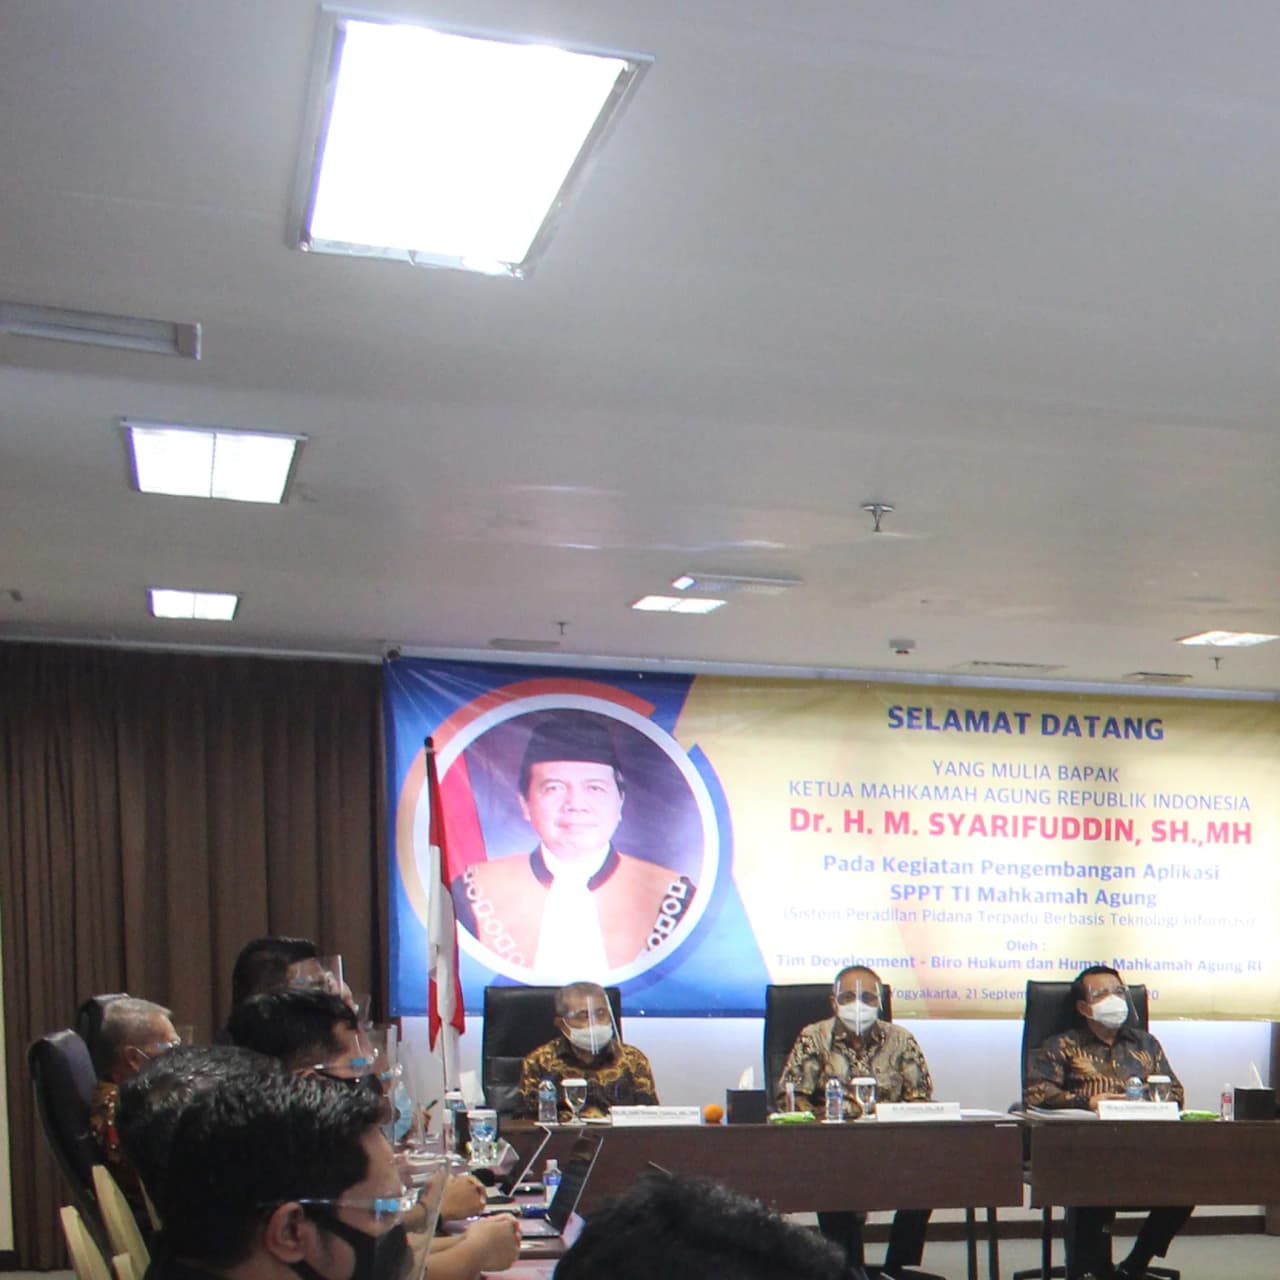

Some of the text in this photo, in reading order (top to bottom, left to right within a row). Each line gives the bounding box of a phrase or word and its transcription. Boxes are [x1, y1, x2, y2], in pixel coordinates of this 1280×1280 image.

[888, 705, 1164, 741] SELAMAT DATANG
[932, 759, 1119, 783] YANG MULIA BAPAK
[789, 780, 1250, 811] KETUA MAHKAMAH AGUNG REPUBLIK INDONESIA
[790, 808, 832, 833] Dr.
[844, 809, 873, 834] H.
[884, 811, 918, 836] M.
[929, 813, 1141, 846] SYARIFUDDIN,
[823, 855, 1219, 881] Pada Kegiatan Pengembangan Aplikasi
[890, 884, 1157, 908] SPPT TI Mahkamah Agung
[847, 907, 917, 923] Peradilan
[922, 909, 972, 924] Pidana
[979, 910, 1038, 926] Terpadu
[1044, 911, 1104, 926] Berbasis
[1006, 939, 1038, 951] Oleh
[776, 954, 806, 967] Tim
[811, 954, 916, 969] Development
[931, 955, 962, 969] Biro
[967, 956, 1021, 970] Hukum
[1026, 957, 1054, 970] dan
[1112, 958, 1193, 972] Mahkamah
[1198, 960, 1243, 974] Agung
[1247, 960, 1262, 972] RI
[981, 988, 1025, 1000] Septem
